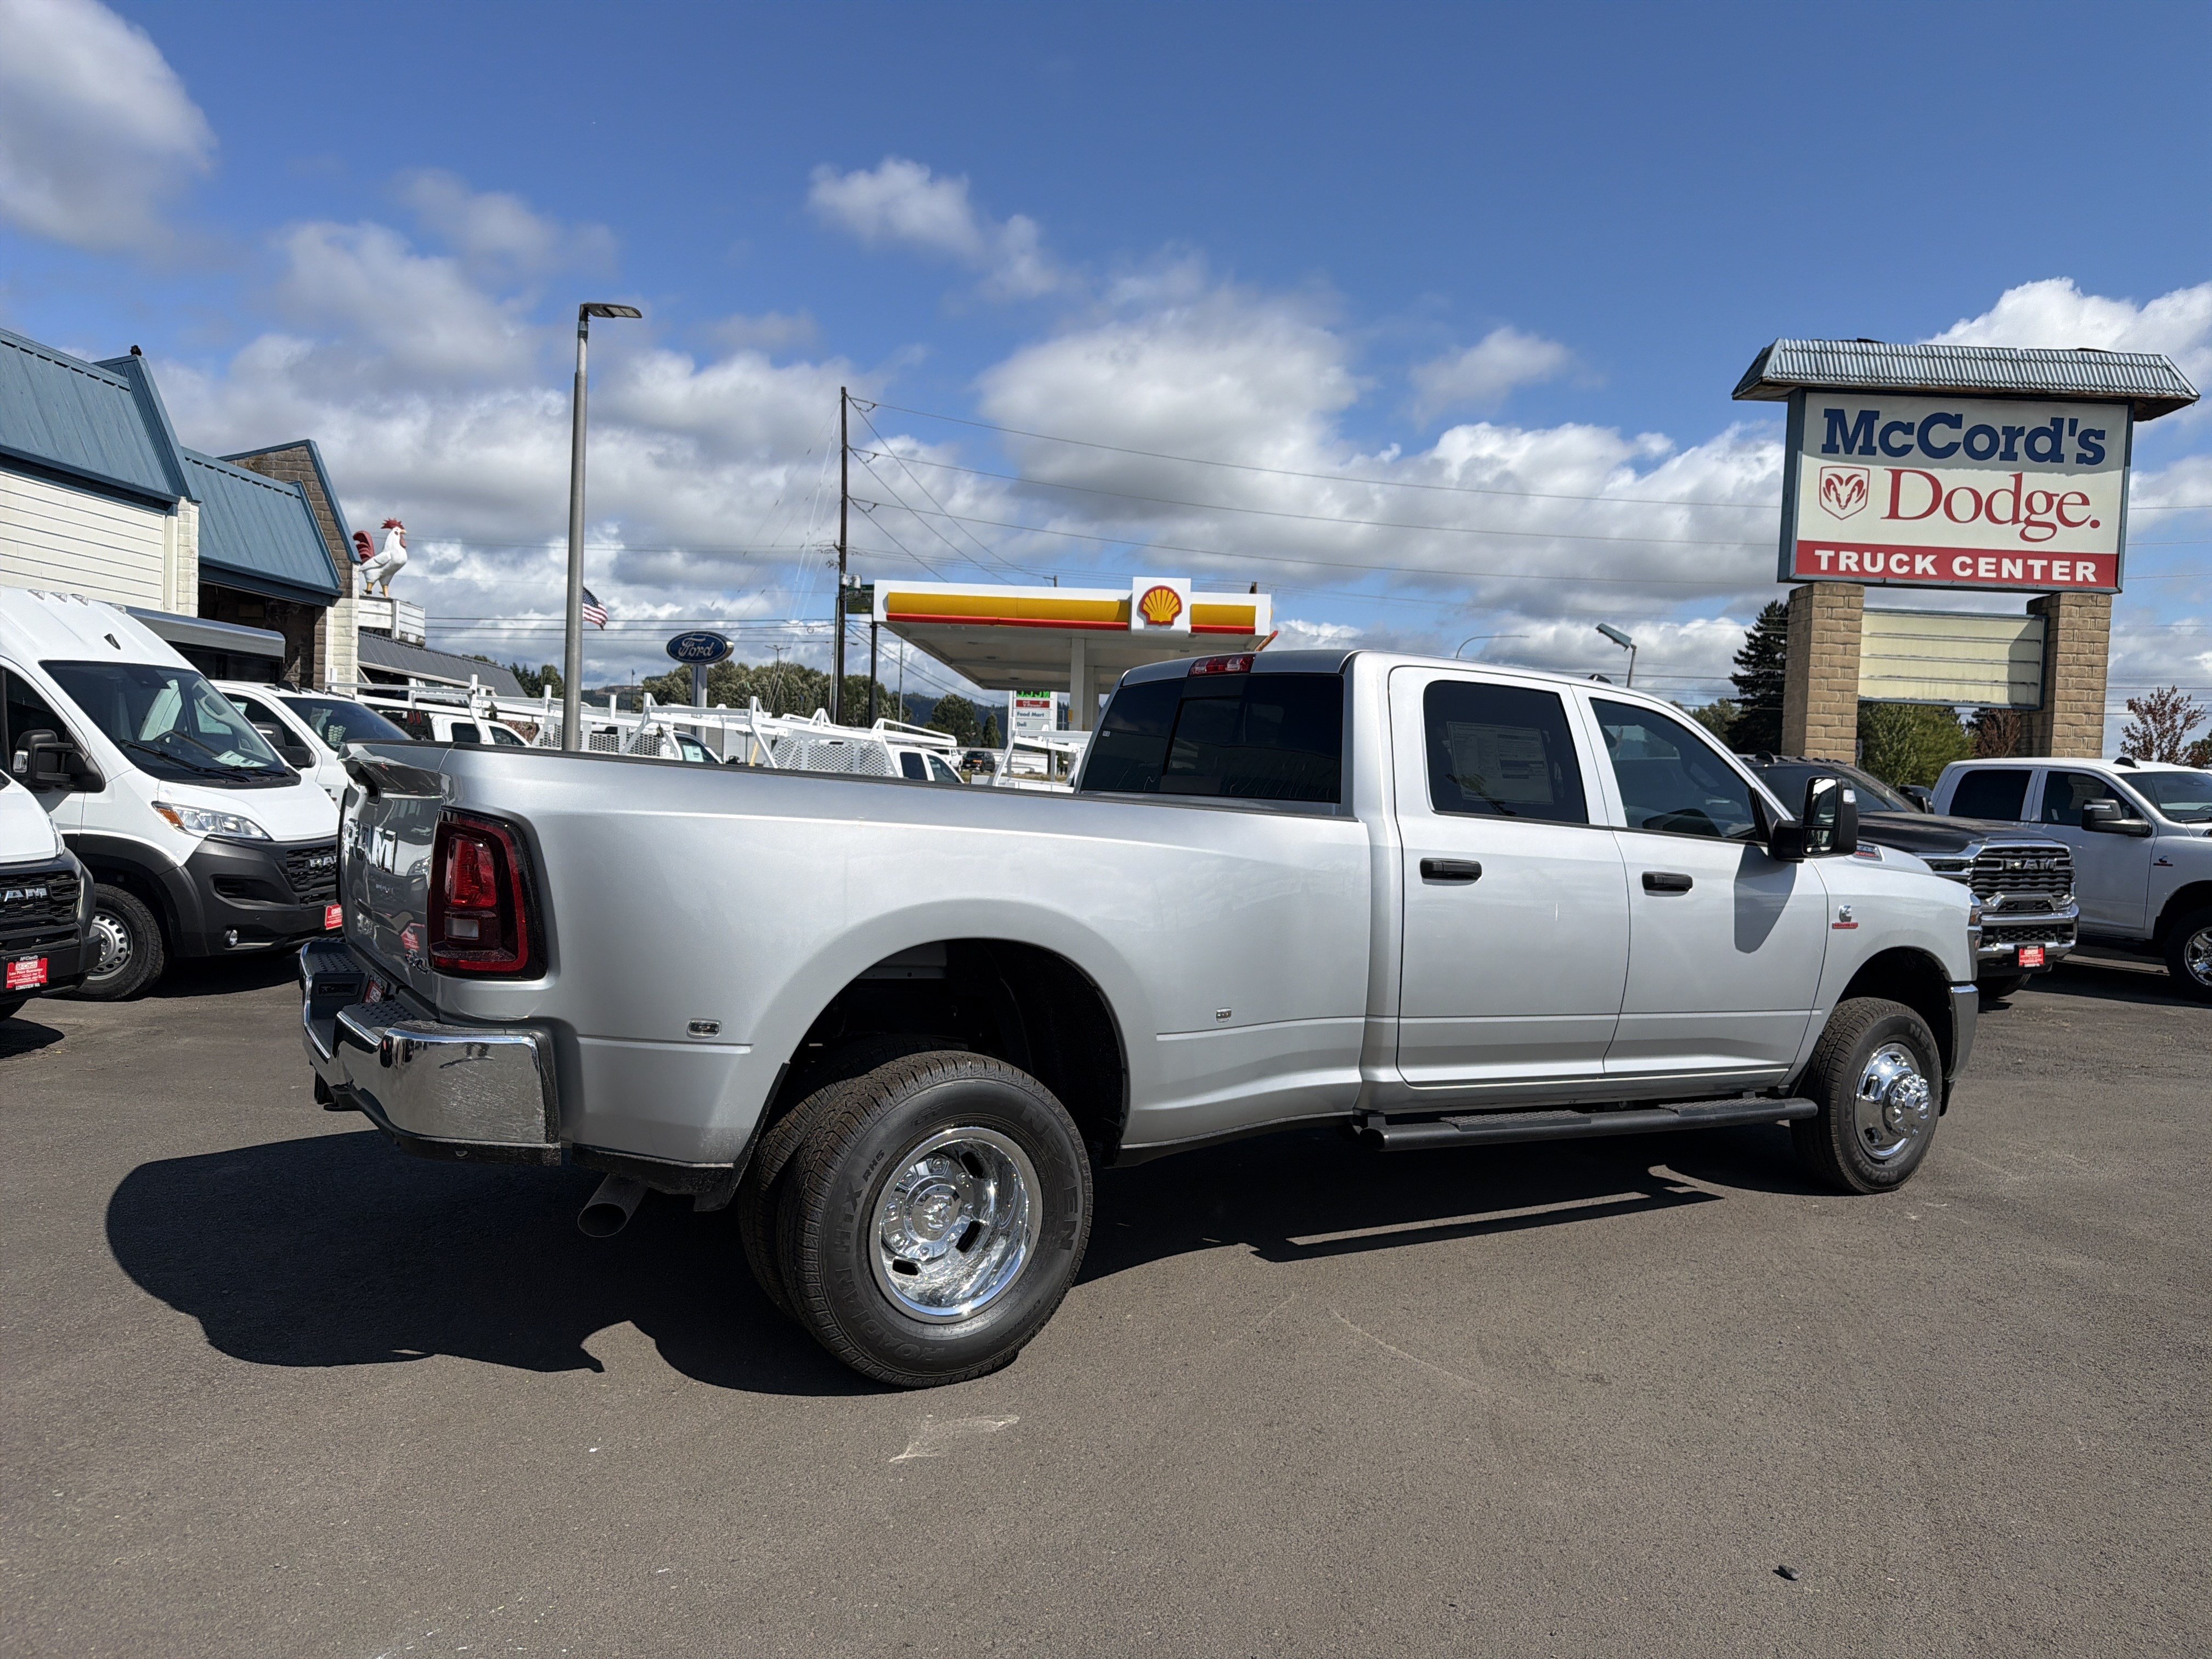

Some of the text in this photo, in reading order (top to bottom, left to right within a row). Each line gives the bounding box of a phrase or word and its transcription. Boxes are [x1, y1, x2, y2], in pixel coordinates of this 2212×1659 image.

[1821, 408, 2106, 466] McCord's
[1814, 550, 2097, 583] TRUCK CENTER
[678, 637, 714, 657] Ford
[2005, 858, 2055, 870] RAM
[0, 888, 48, 902] AM
